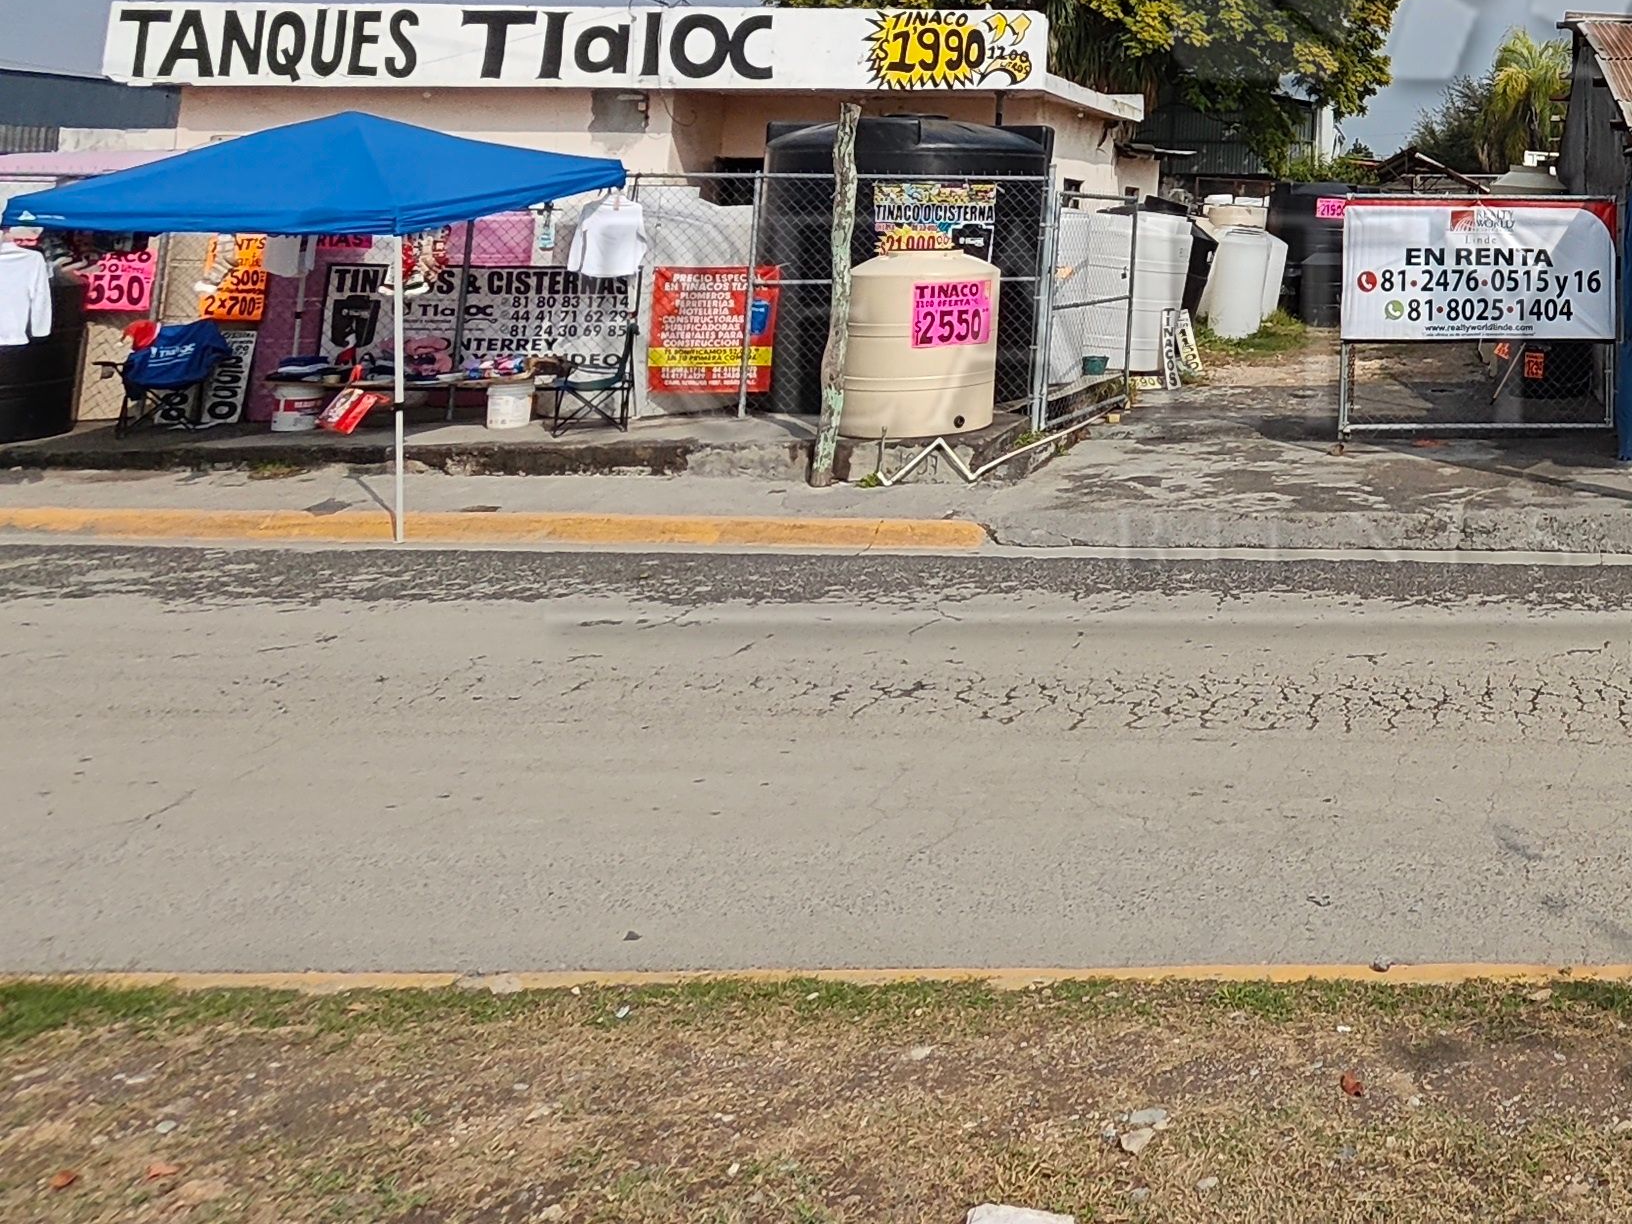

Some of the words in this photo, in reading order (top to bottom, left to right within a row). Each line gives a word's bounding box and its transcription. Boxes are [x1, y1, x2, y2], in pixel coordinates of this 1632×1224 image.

[892, 11, 968, 30] TINACO
[119, 9, 419, 82] TANQUES
[876, 204, 920, 222] TINACO
[924, 204, 932, 222] O
[935, 204, 994, 222] CISTERNA
[1465, 236, 1497, 244] Linde
[1406, 248, 1445, 266] EN
[1454, 248, 1554, 267] RENTA
[673, 274, 713, 282] PRECIO
[1555, 275, 1569, 298] y
[1574, 270, 1601, 293] 16
[664, 282, 678, 291] EN
[681, 282, 729, 291] TINACOS
[915, 283, 979, 299] TINACO
[512, 296, 529, 308] 81
[536, 296, 557, 308] 80
[562, 296, 580, 308] 83
[588, 296, 605, 308] 17
[612, 296, 629, 308] 14
[510, 310, 530, 323] 44
[535, 310, 553, 323] 41
[560, 310, 578, 323] 71
[584, 310, 602, 323] 62
[609, 310, 628, 323] 29
[509, 325, 527, 337] 81
[534, 325, 553, 337] 24
[558, 325, 577, 337] 30
[583, 325, 602, 337] 69
[661, 331, 716, 339] MATERIALES
[718, 331, 744, 339] PARA
[1162, 308, 1178, 387] TINACOS
